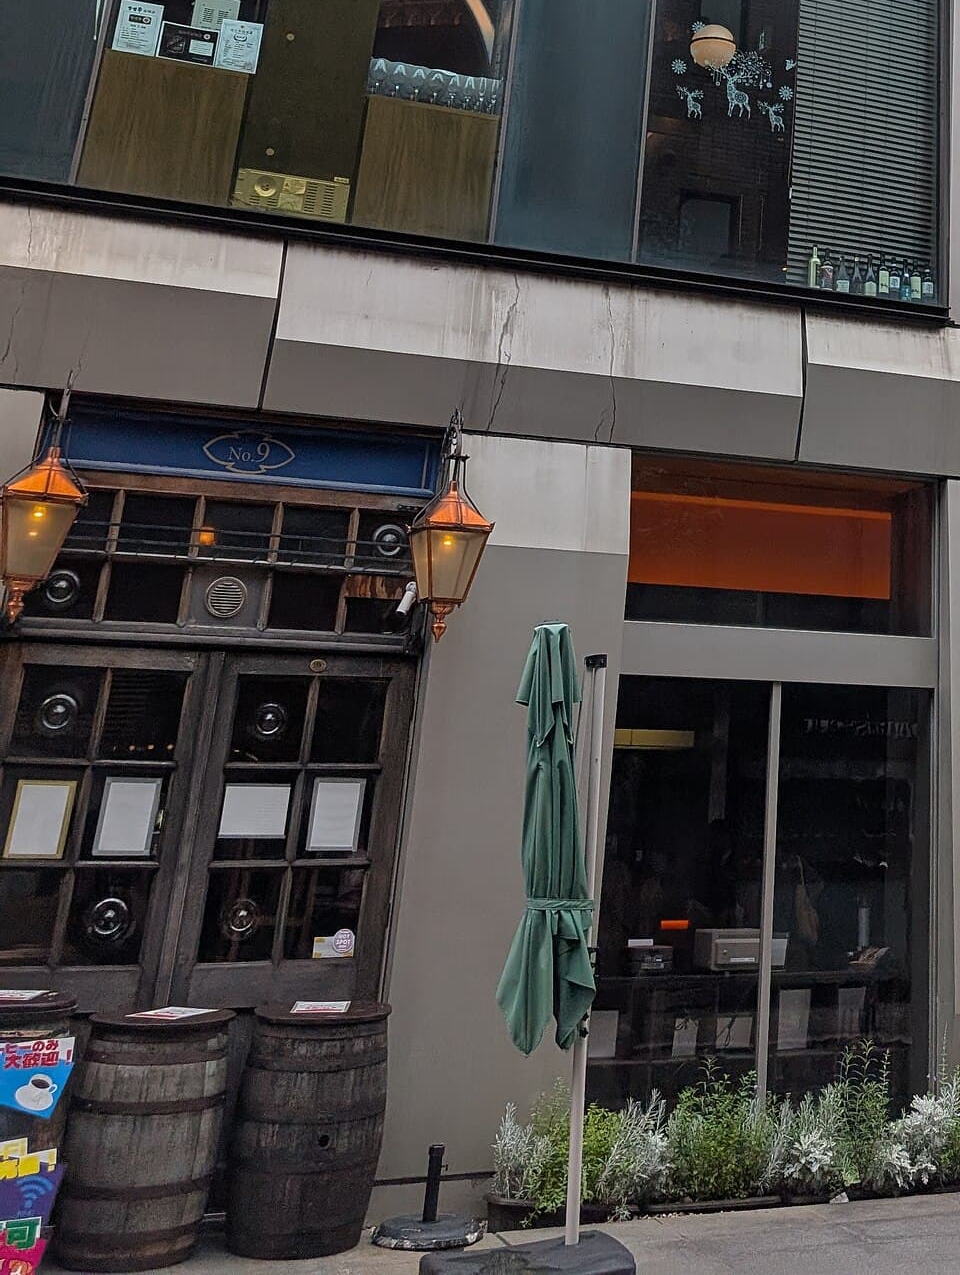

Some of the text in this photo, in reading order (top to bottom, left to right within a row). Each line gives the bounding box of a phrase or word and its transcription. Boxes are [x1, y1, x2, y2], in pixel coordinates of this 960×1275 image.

[229, 442, 271, 463] No.9
[0, 1039, 60, 1054] ヒーのみ
